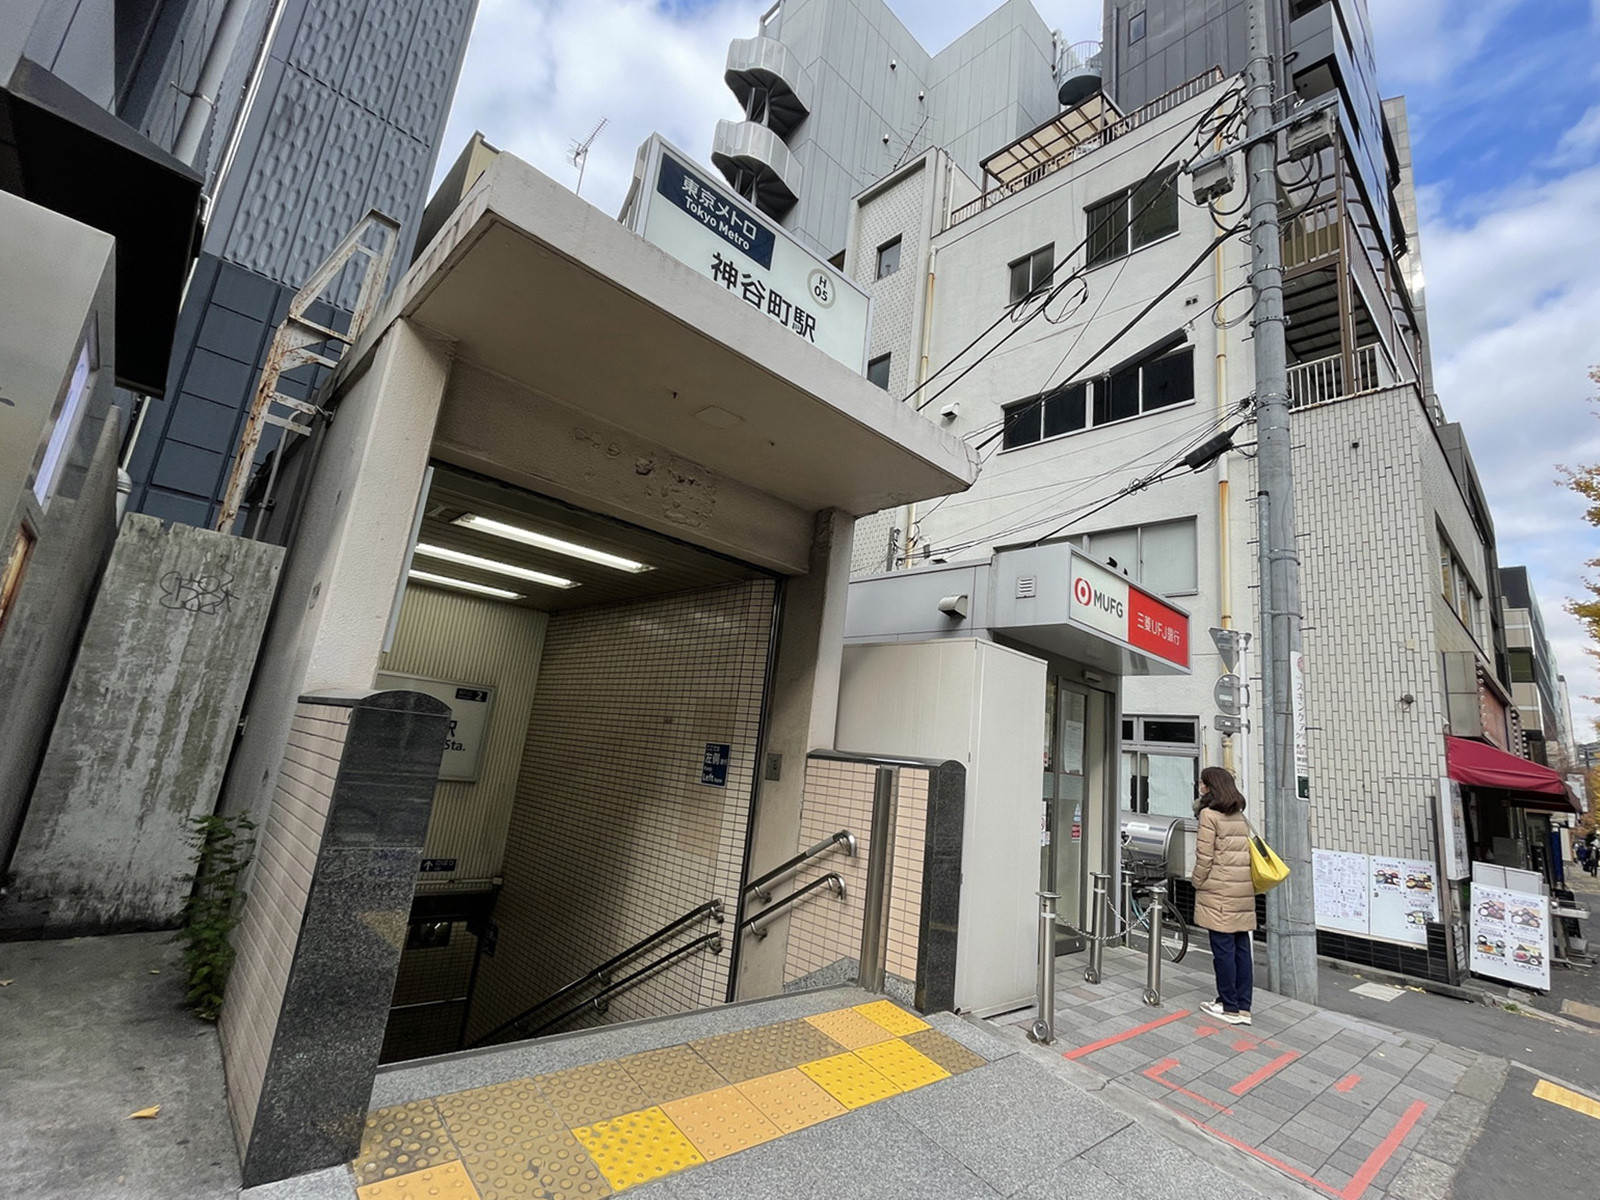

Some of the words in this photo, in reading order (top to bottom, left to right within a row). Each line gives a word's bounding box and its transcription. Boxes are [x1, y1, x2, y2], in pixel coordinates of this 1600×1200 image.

[682, 175, 757, 240] 東京メトロ
[685, 196, 717, 227] Tokyo
[719, 221, 750, 250] Metro
[814, 286, 829, 302] 05
[818, 275, 828, 287] H
[710, 252, 816, 343] 神谷町駅
[1093, 589, 1124, 619] MUFG
[1137, 612, 1180, 646] 三菱UFJ銀行
[475, 691, 483, 701] 2
[444, 739, 466, 752] Sta.
